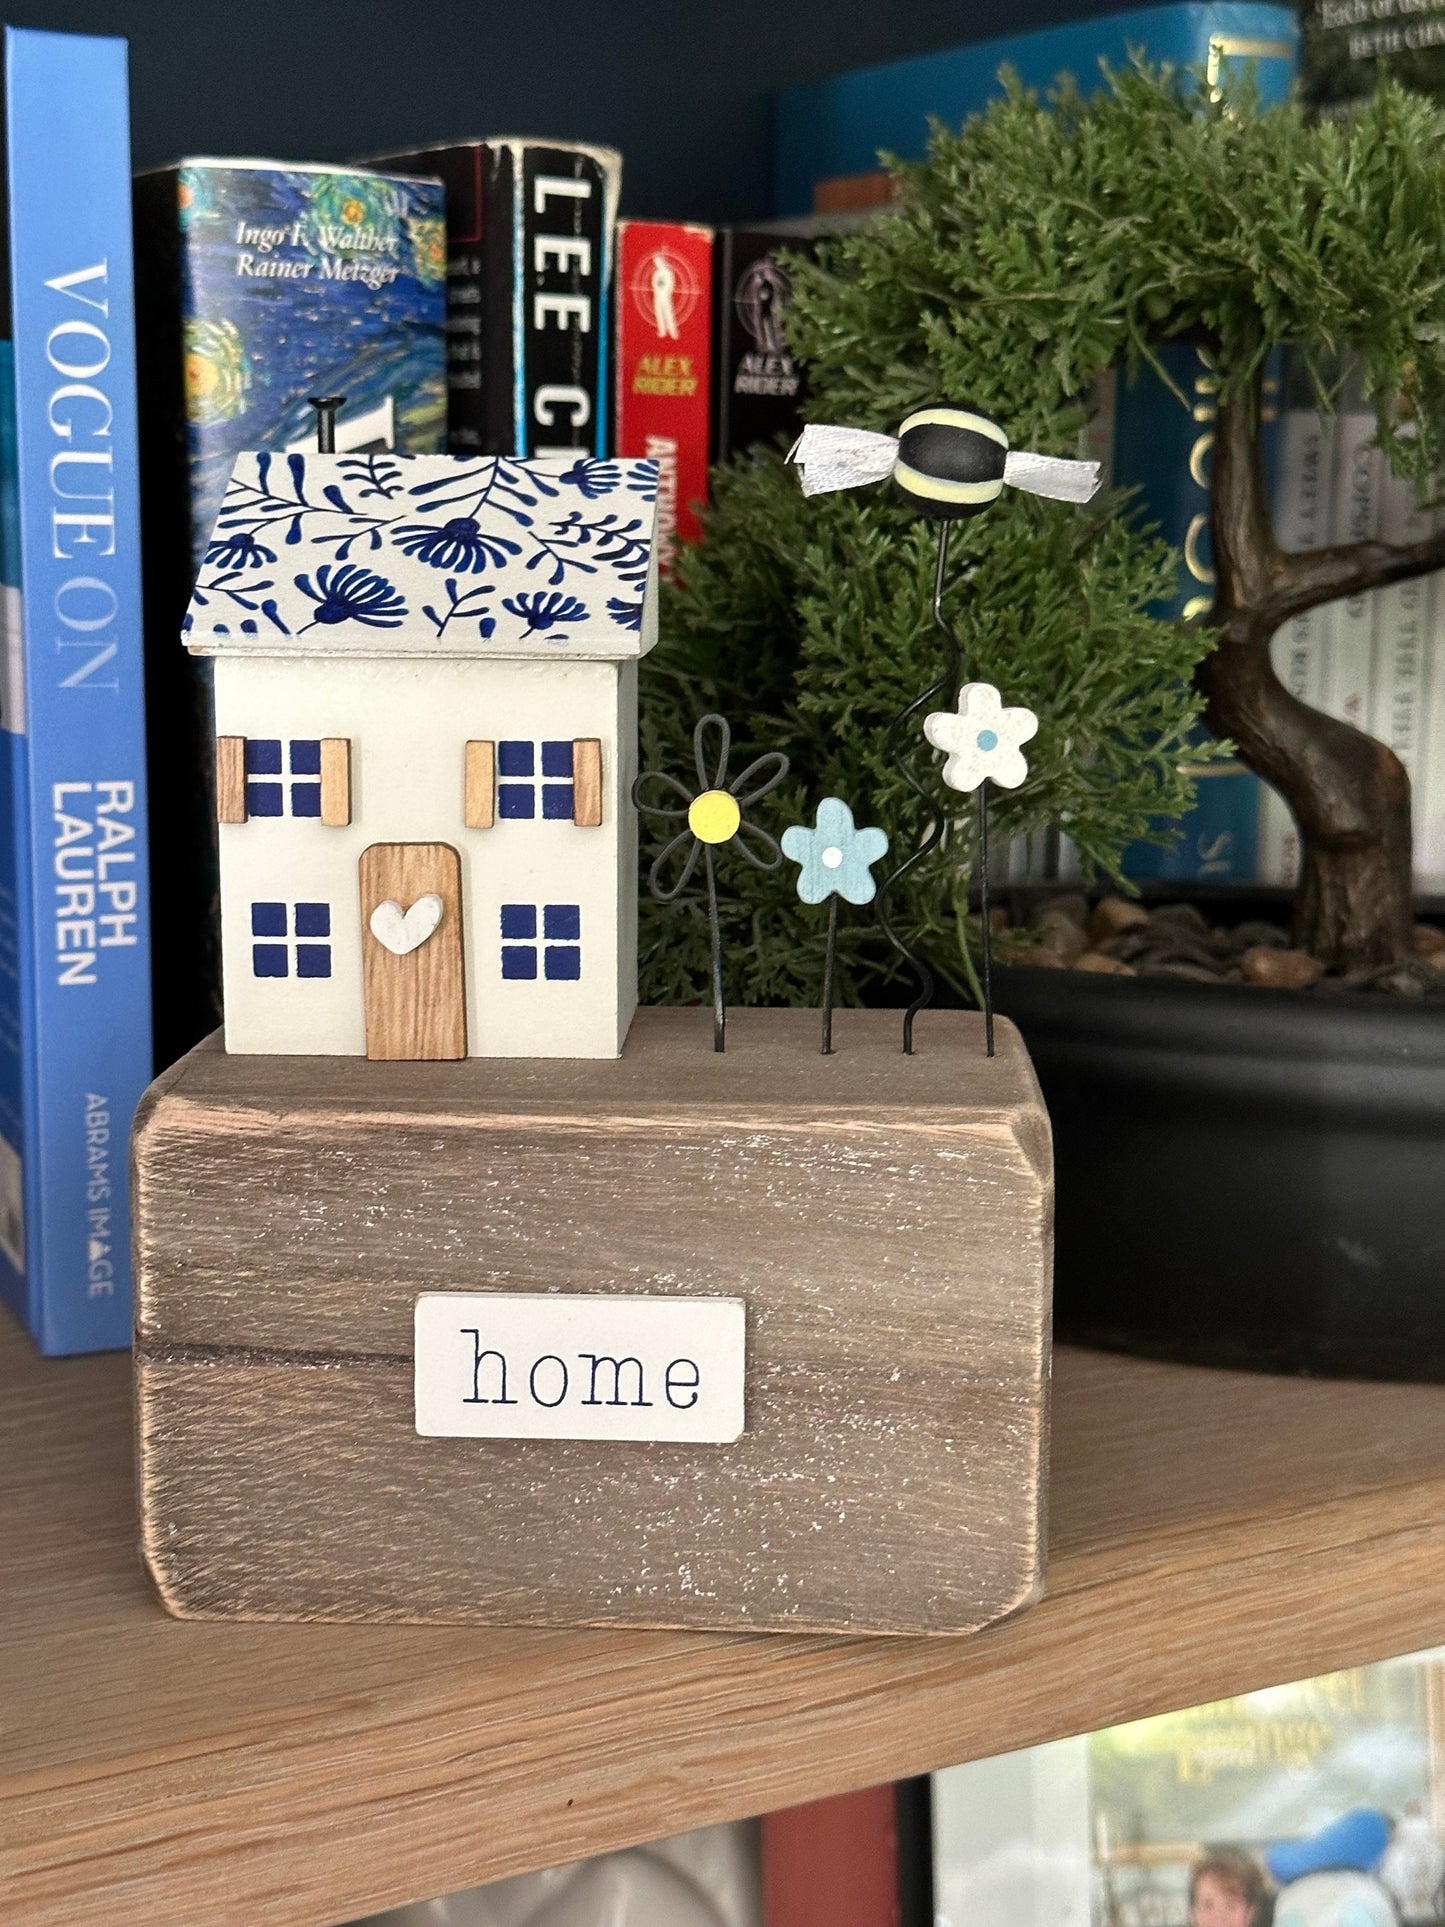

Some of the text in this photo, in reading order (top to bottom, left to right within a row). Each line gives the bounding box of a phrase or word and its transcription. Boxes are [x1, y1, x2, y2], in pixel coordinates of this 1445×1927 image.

[236, 221, 285, 252] Ingo
[317, 225, 398, 252] Walther
[236, 253, 400, 290] Rainer Metzger
[533, 174, 592, 458] LEE C
[631, 376, 698, 396] RIDER
[639, 354, 694, 375] ALEX
[737, 353, 794, 375] ALEX
[44, 257, 120, 695] VOGUE ON
[53, 781, 98, 986] LAUREN
[96, 780, 138, 948] RALPH
[84, 1092, 114, 1298] ABRAMS IMAGE
[460, 1328, 700, 1410] home
